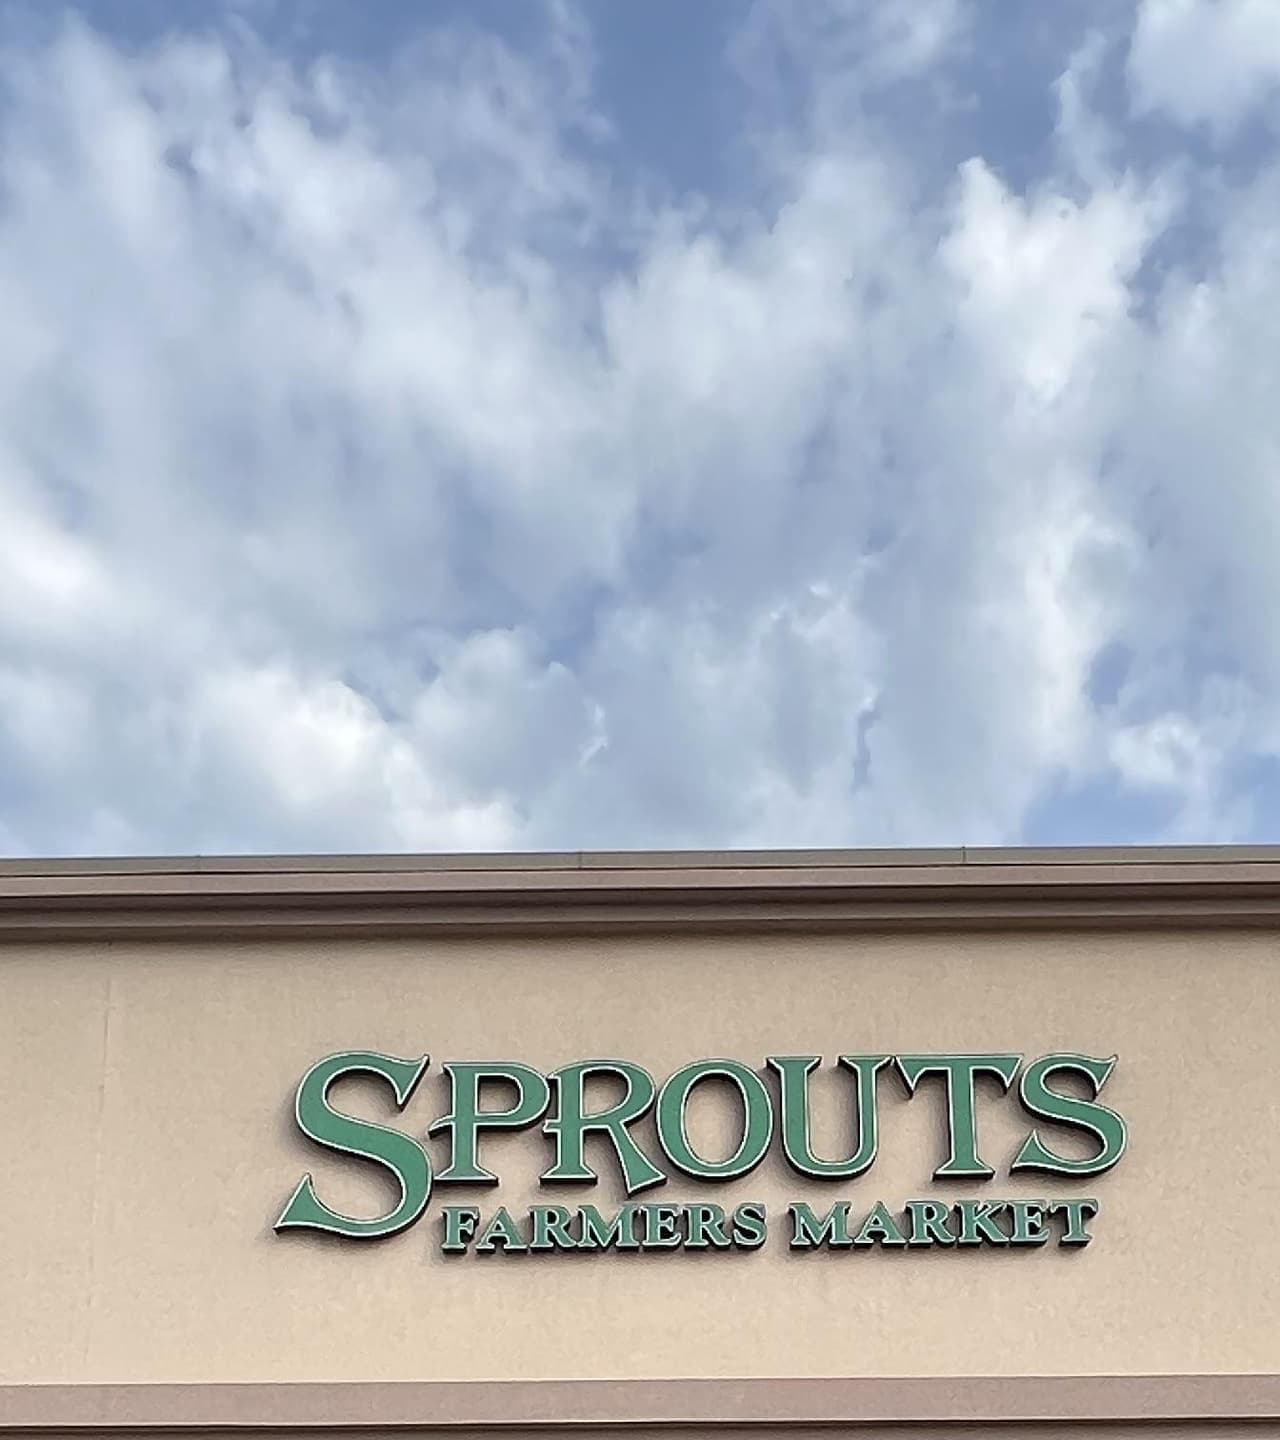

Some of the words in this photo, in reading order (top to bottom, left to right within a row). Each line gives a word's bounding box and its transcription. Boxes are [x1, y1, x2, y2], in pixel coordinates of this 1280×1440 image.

[273, 1050, 1129, 1242] SPROUTS
[440, 1200, 766, 1254] FARMERS
[788, 1199, 1101, 1252] MARKET
